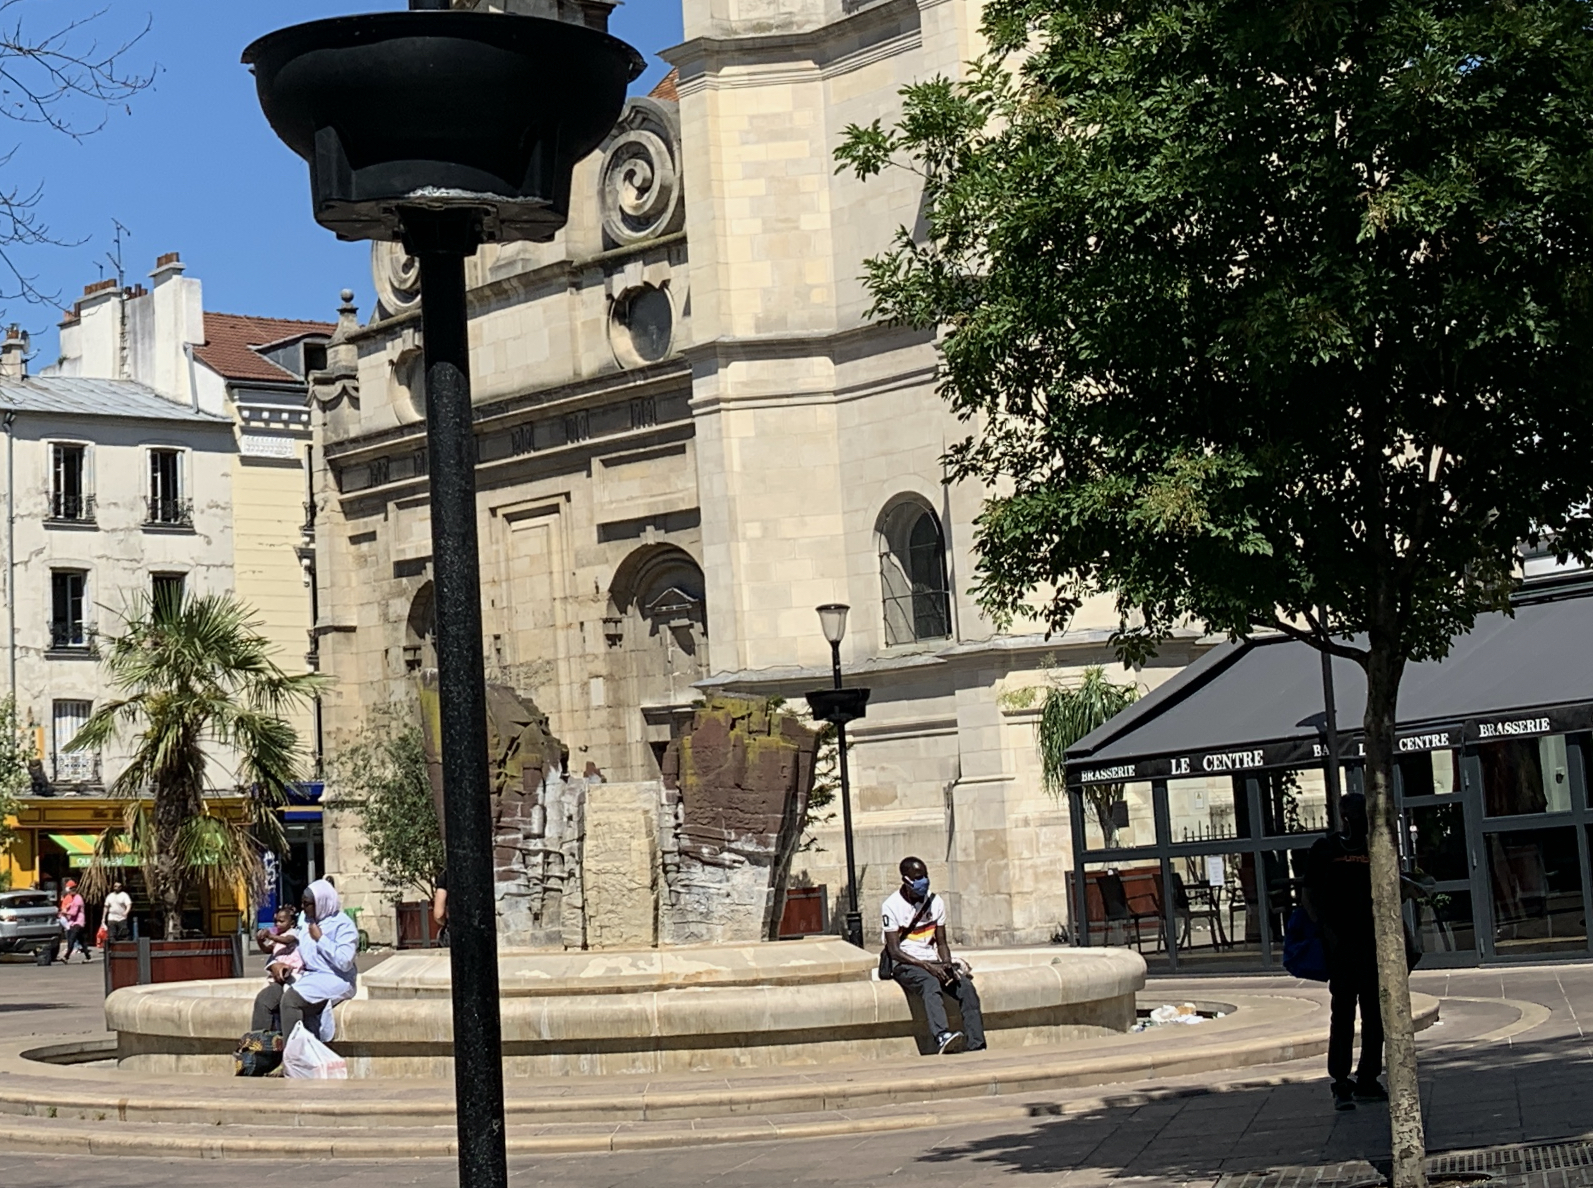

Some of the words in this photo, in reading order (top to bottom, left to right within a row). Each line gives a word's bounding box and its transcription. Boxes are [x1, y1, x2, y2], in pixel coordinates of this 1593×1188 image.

[1479, 717, 1550, 737] BRASSERIE
[1312, 744, 1331, 757] BA
[1399, 733, 1449, 751] CENTRE
[1170, 757, 1190, 775] LE
[1202, 750, 1264, 772] CENTRE
[1081, 765, 1136, 782] BRASSERIE
